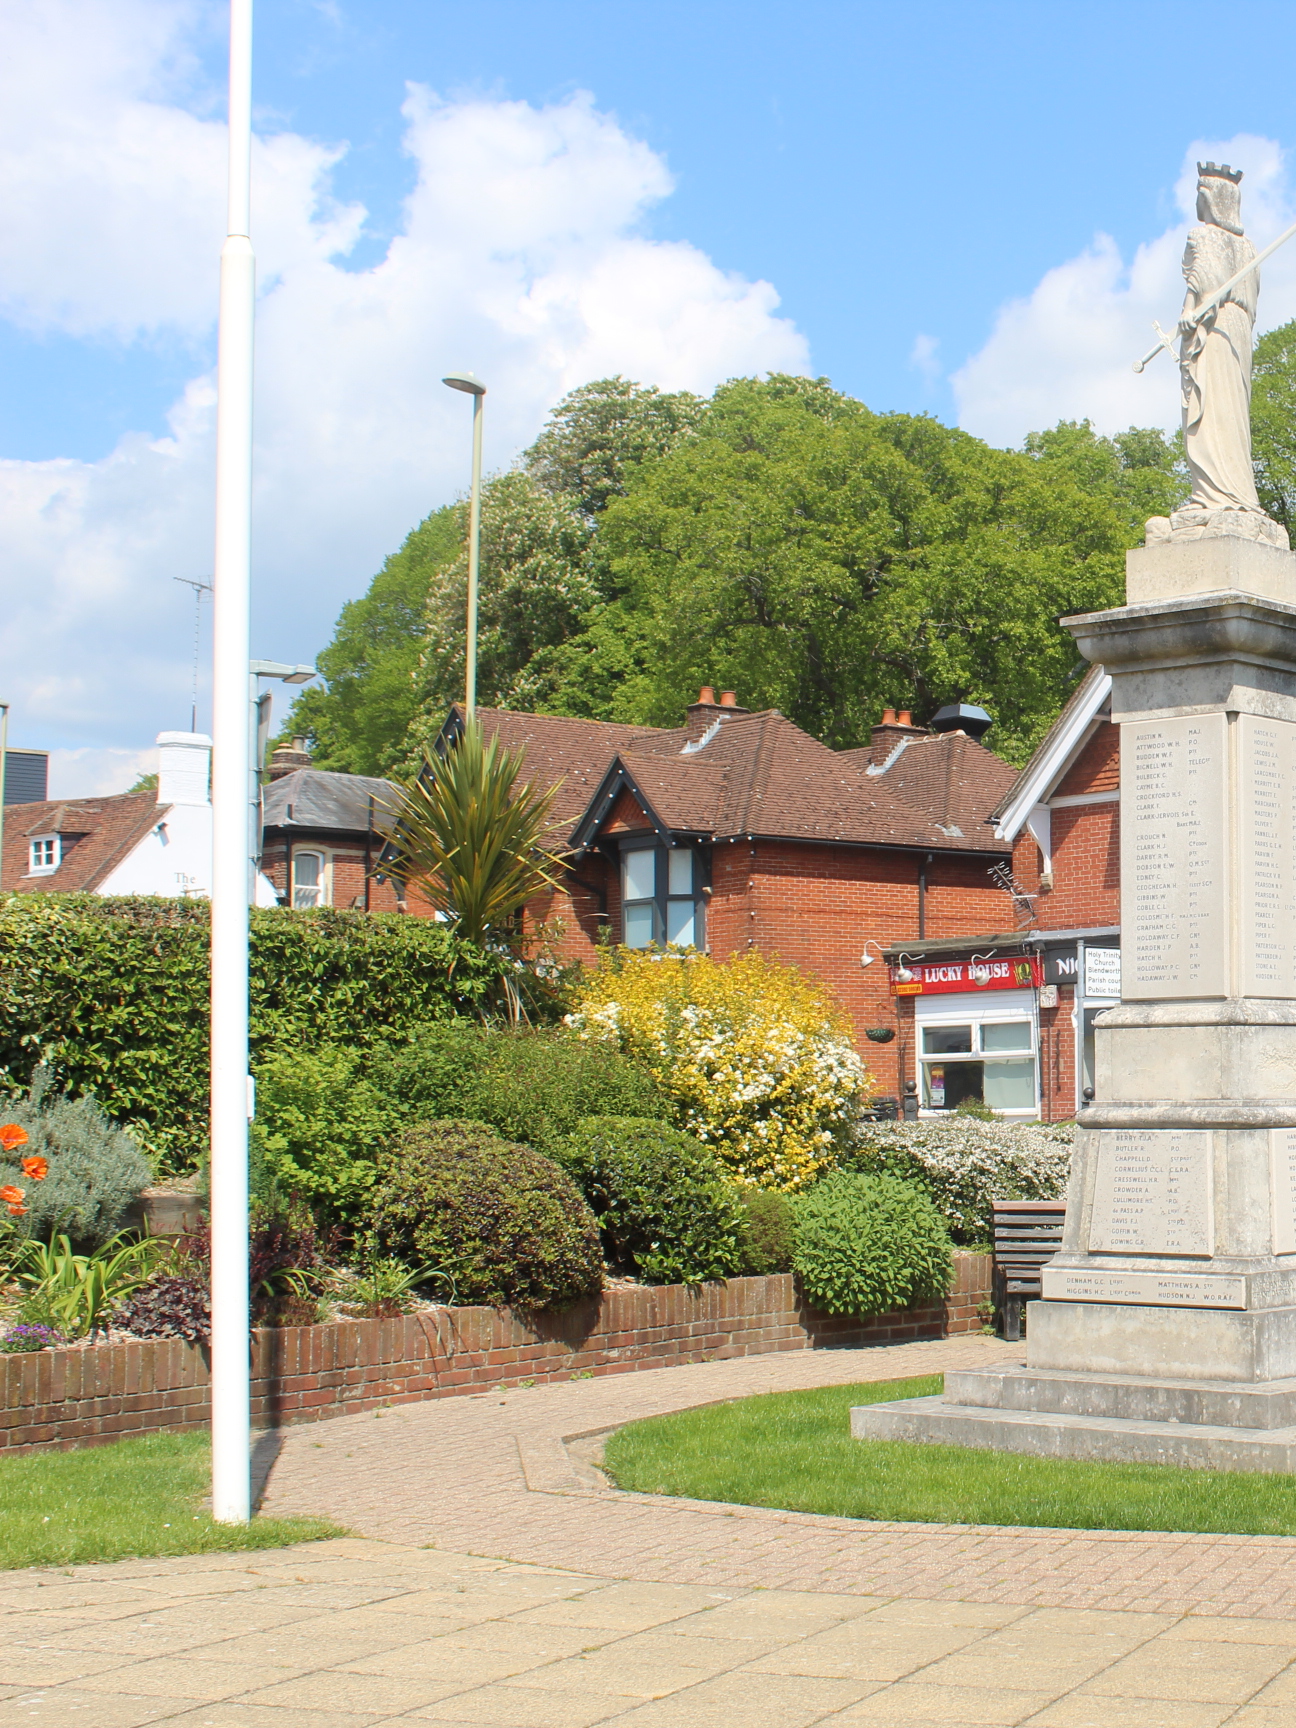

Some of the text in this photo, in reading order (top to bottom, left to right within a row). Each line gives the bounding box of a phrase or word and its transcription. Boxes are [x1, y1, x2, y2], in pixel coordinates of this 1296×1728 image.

[174, 872, 196, 884] The
[924, 965, 963, 983] LUCKY
[968, 962, 1010, 980] HOUSE
[1088, 986, 1107, 994] Public
